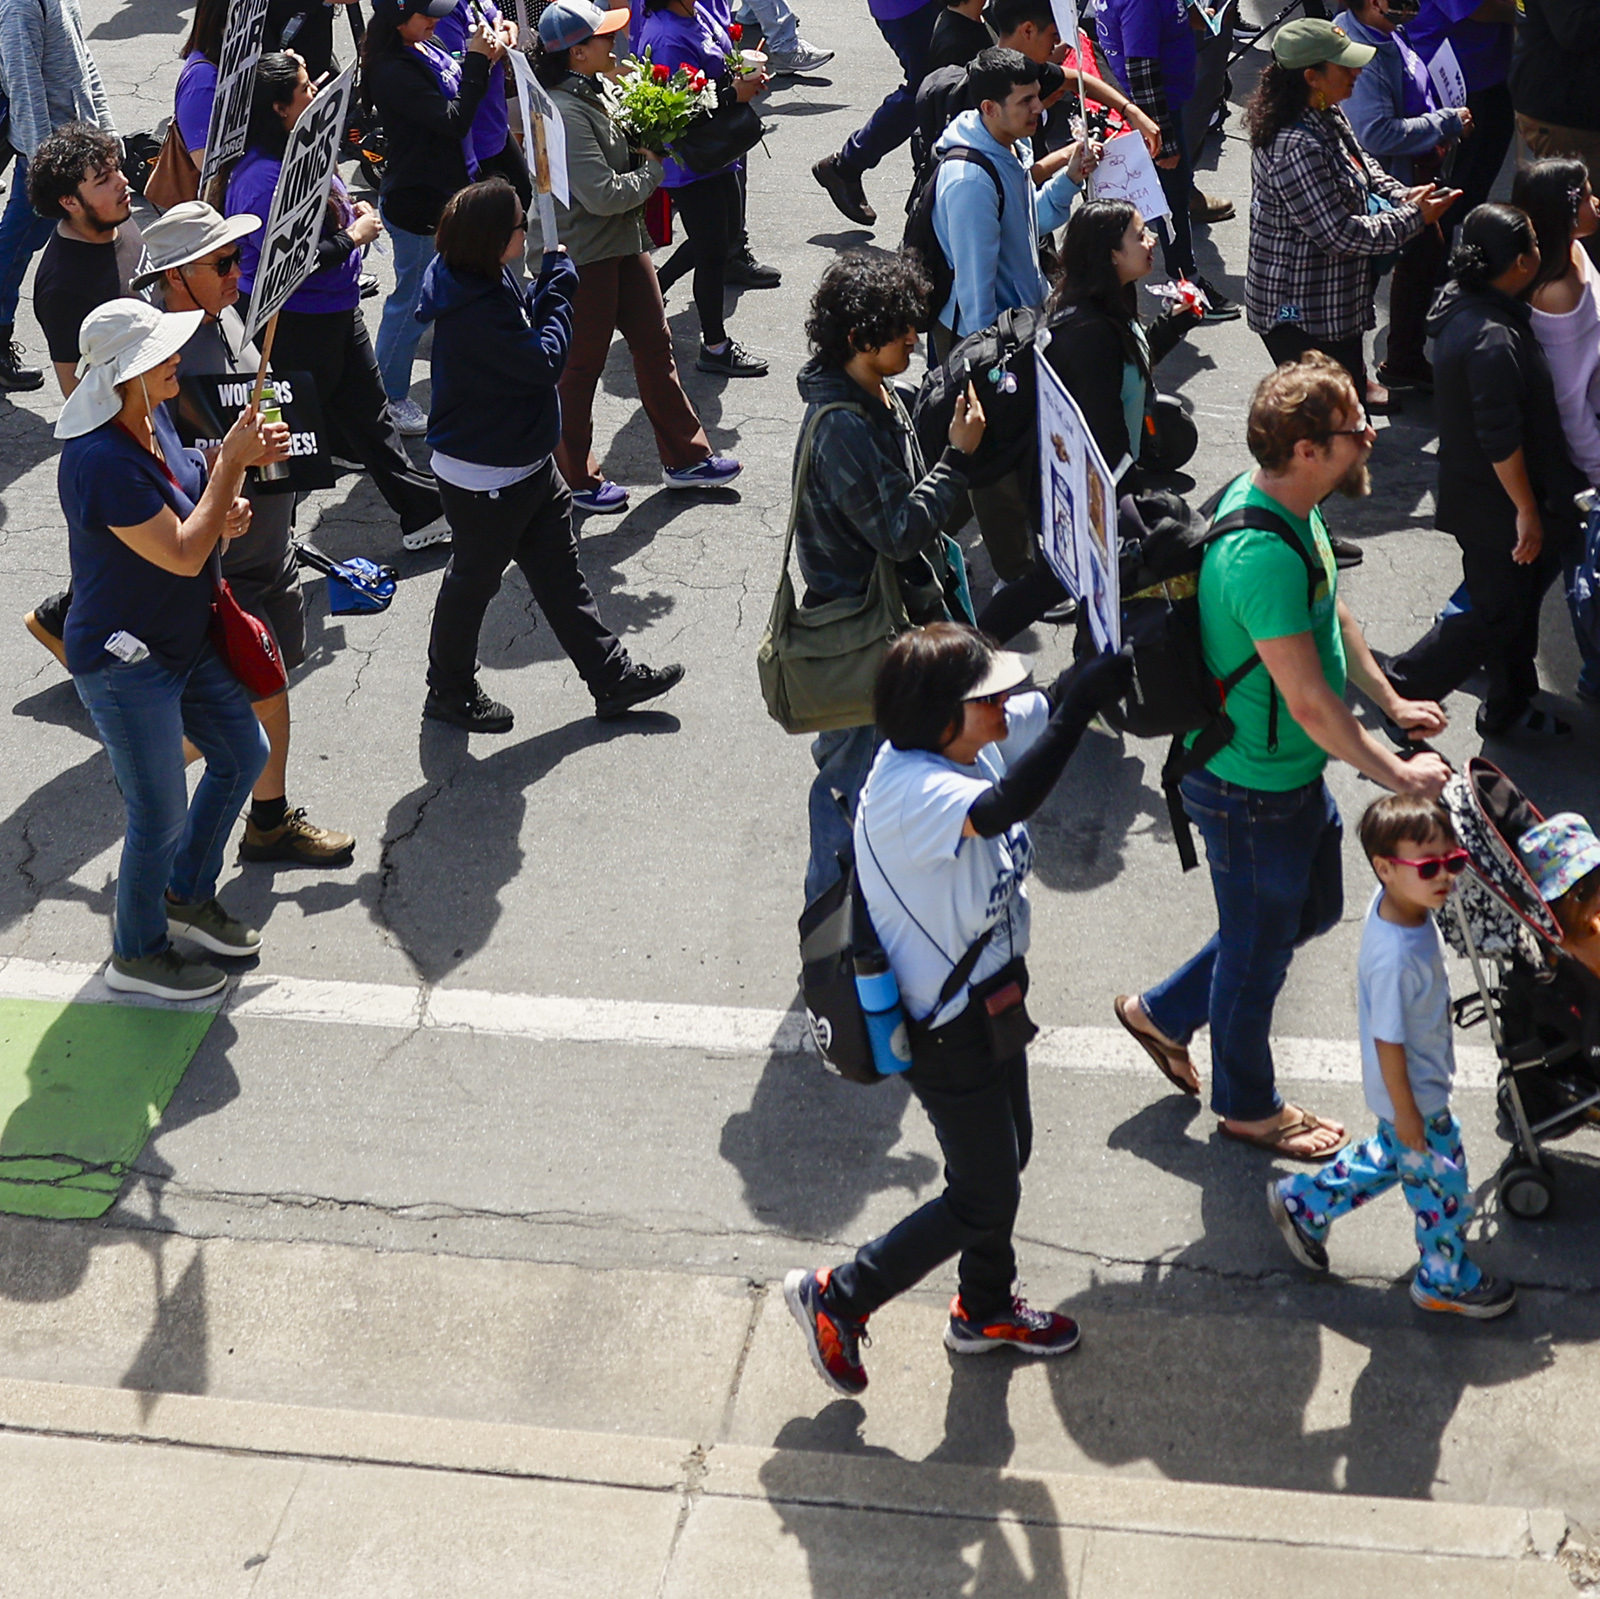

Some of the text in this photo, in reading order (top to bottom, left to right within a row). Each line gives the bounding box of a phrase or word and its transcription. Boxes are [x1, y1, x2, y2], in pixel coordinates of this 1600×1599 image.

[289, 88, 344, 166] NO
[278, 125, 338, 221] KINGS
[264, 193, 323, 271] NO
[259, 237, 313, 310] WARS
